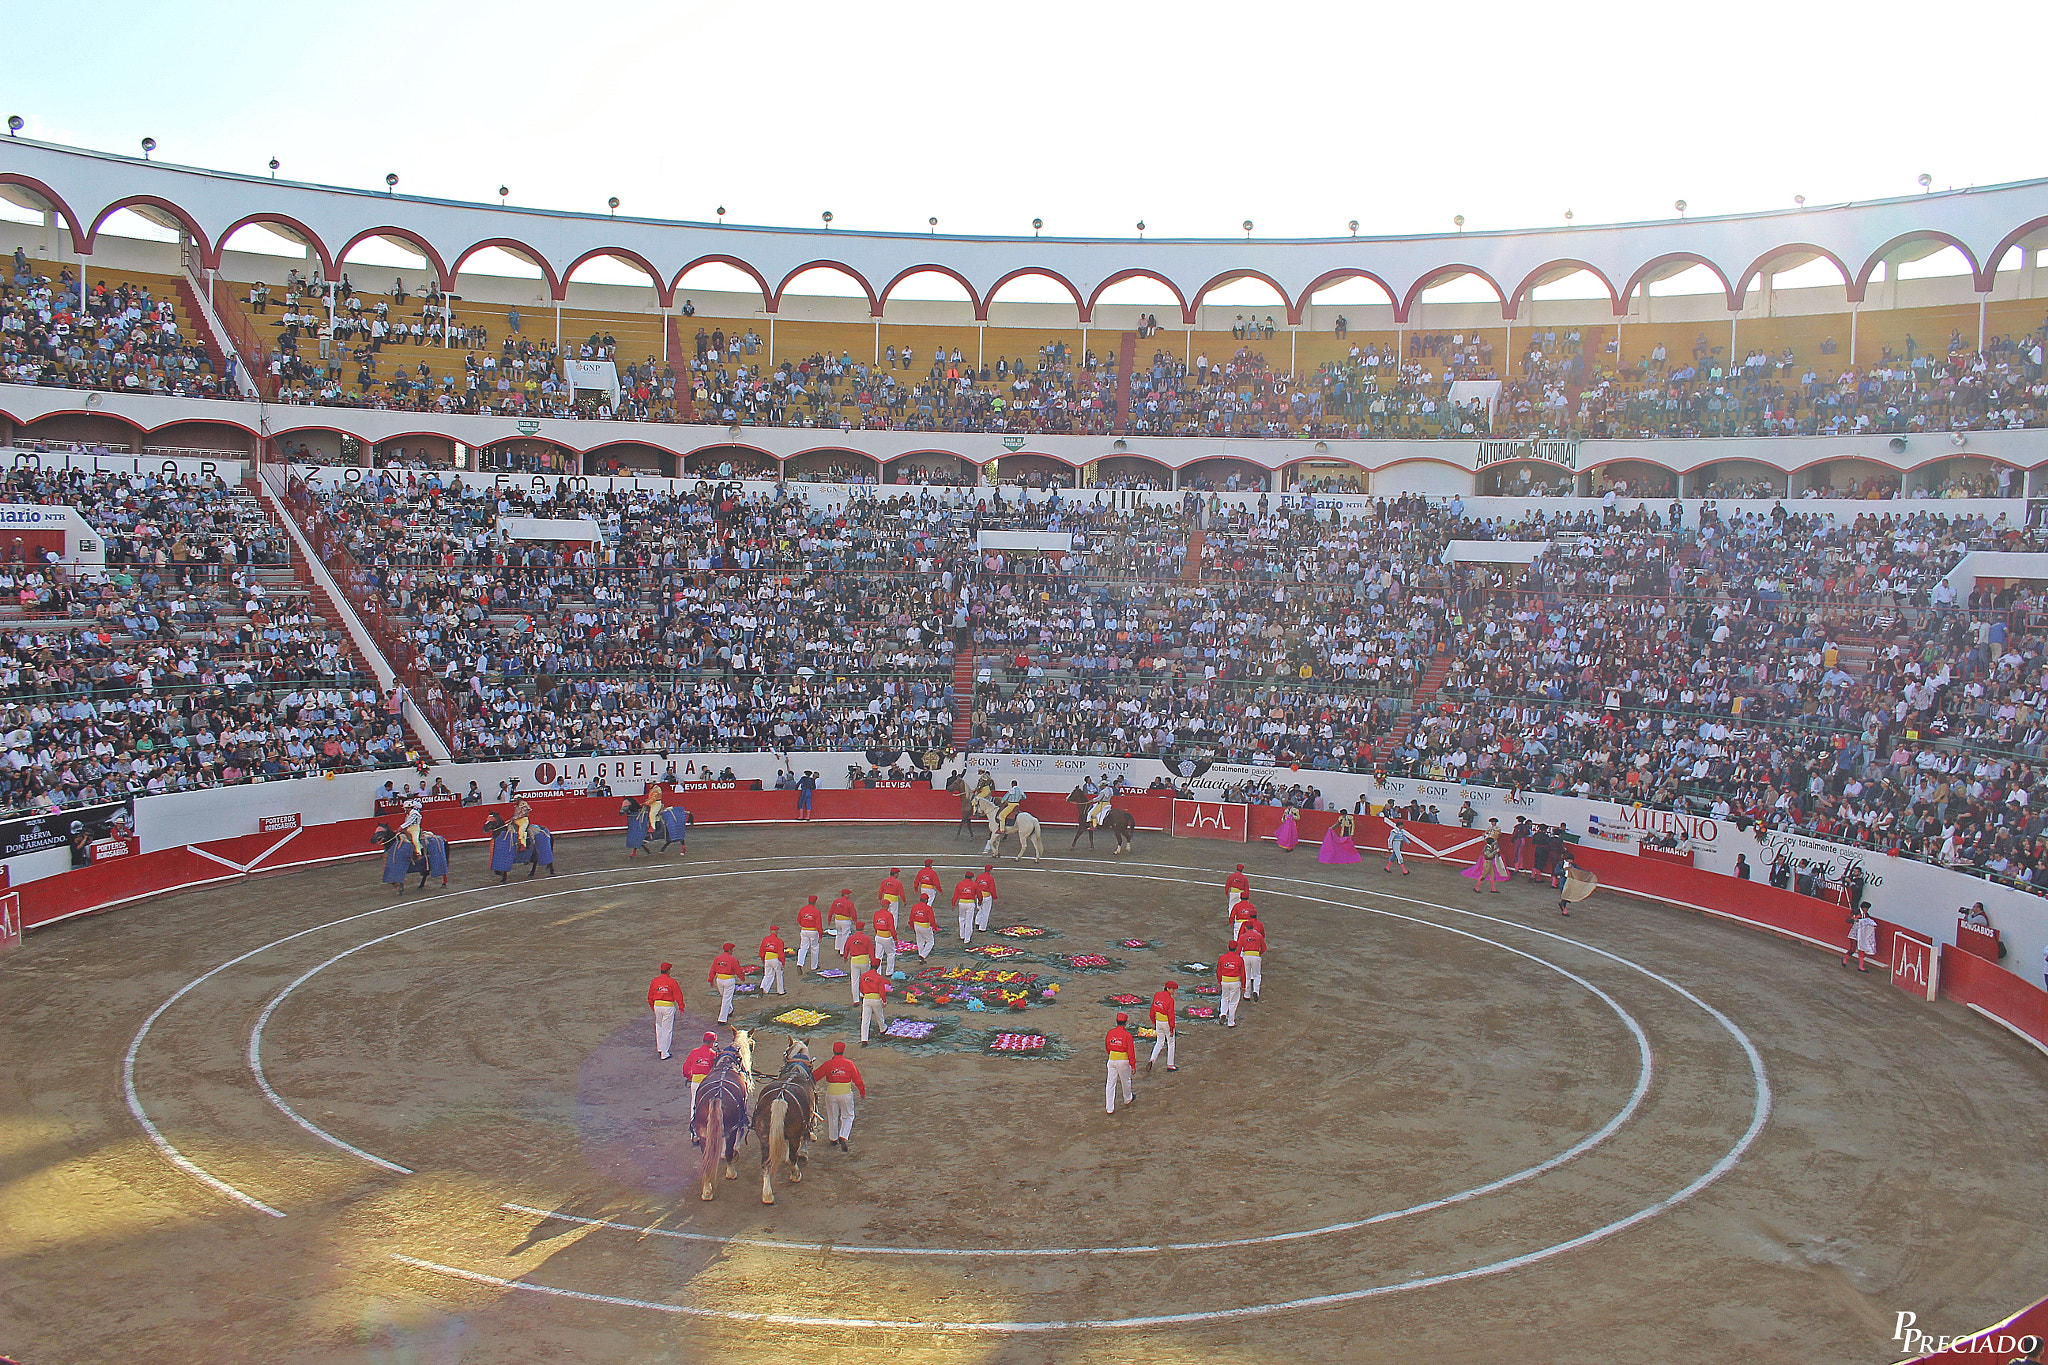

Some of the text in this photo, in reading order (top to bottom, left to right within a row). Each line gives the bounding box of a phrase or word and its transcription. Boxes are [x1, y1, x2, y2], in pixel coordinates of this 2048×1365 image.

[1475, 442, 1518, 470] AUTORIDAD
[1532, 442, 1577, 470] AUTORIDAD
[1300, 495, 1343, 510] ario
[45, 513, 66, 521] NTR
[977, 758, 999, 767] GNP
[1021, 759, 1043, 768] GNP
[1064, 760, 1086, 769] GNP
[1107, 762, 1129, 771] GNP
[1251, 768, 1275, 776] palacio
[669, 782, 735, 791] TEVISA RADIO
[875, 781, 912, 789] ELEVISA
[1383, 782, 1405, 791] GNP
[522, 790, 564, 799] RADIORAMA
[1119, 787, 1147, 795] ATADO
[1426, 786, 1448, 796] GNP
[1469, 791, 1491, 800] GNP
[265, 815, 296, 824] PORTEROS
[1619, 806, 1718, 842] MILENIO
[20, 830, 52, 843] RESERVA
[5, 844, 26, 854] DON
[26, 835, 67, 850] ARMANDO
[96, 841, 127, 853] PORTEROS
[1799, 837, 1838, 853] totalmente
[1840, 846, 1864, 859] palacio
